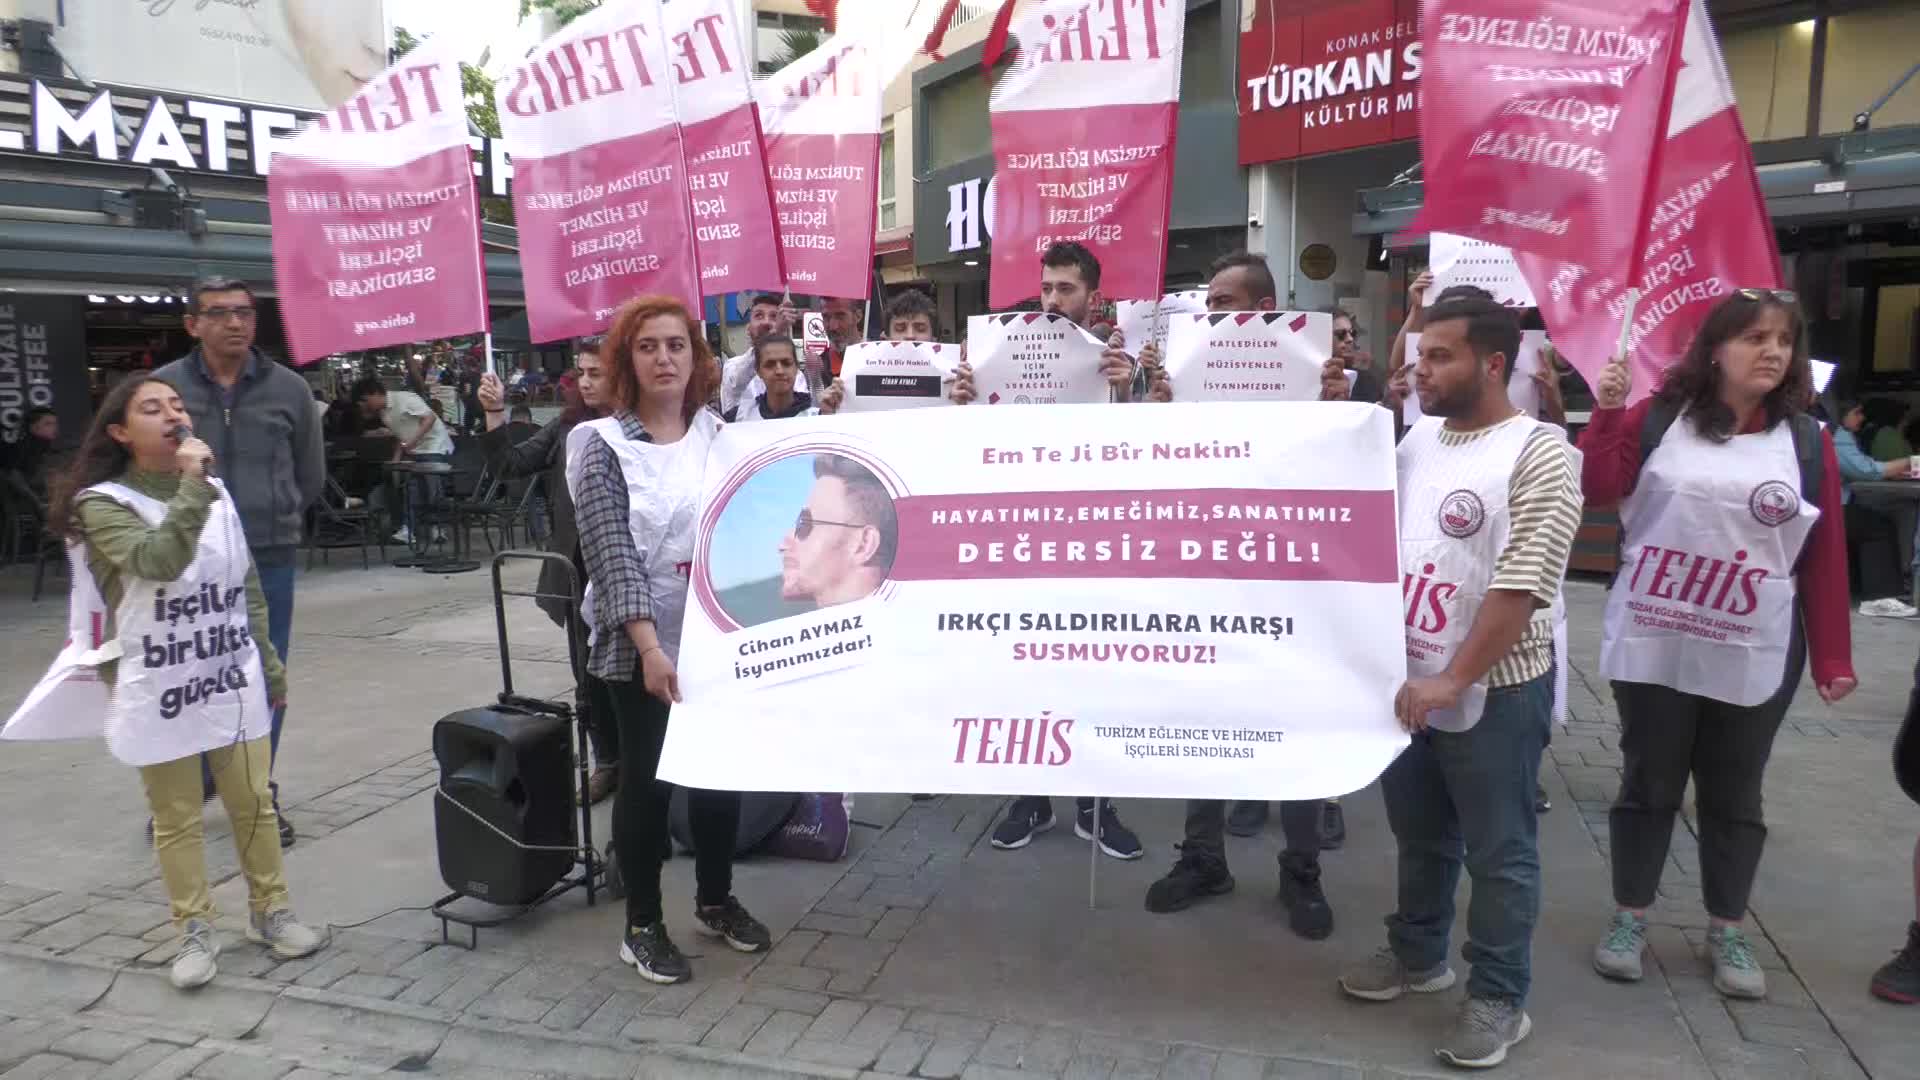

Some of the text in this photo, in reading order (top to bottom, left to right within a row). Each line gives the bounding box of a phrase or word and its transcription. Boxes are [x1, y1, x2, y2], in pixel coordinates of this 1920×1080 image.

[1326, 20, 1419, 55] KONAK BEL
[1247, 48, 1392, 111] TÜRKAN
[1304, 96, 1388, 128] KÜLTÜR
[1209, 339, 1279, 349] KATLEDİLEN
[1206, 359, 1284, 370] MÜZİSYENLER
[982, 440, 1252, 465] Em Te Ji Bîr Nakin!
[958, 531, 1321, 564] DEĞERSİZ DEĞİL!
[1629, 544, 1769, 617] TEHİS
[738, 615, 864, 657] Cihan AYMAZ
[937, 612, 1294, 641] IRKÇI SALDIRILARA KARŞI
[1012, 642, 1218, 665] SUSMUYORUZ!
[953, 710, 1077, 767] TEHİS
[1094, 725, 1284, 743] TURİZM EĞLENCE VE HİZMET
[1124, 743, 1255, 760] İŞÇİLERİ SENDİKASI
